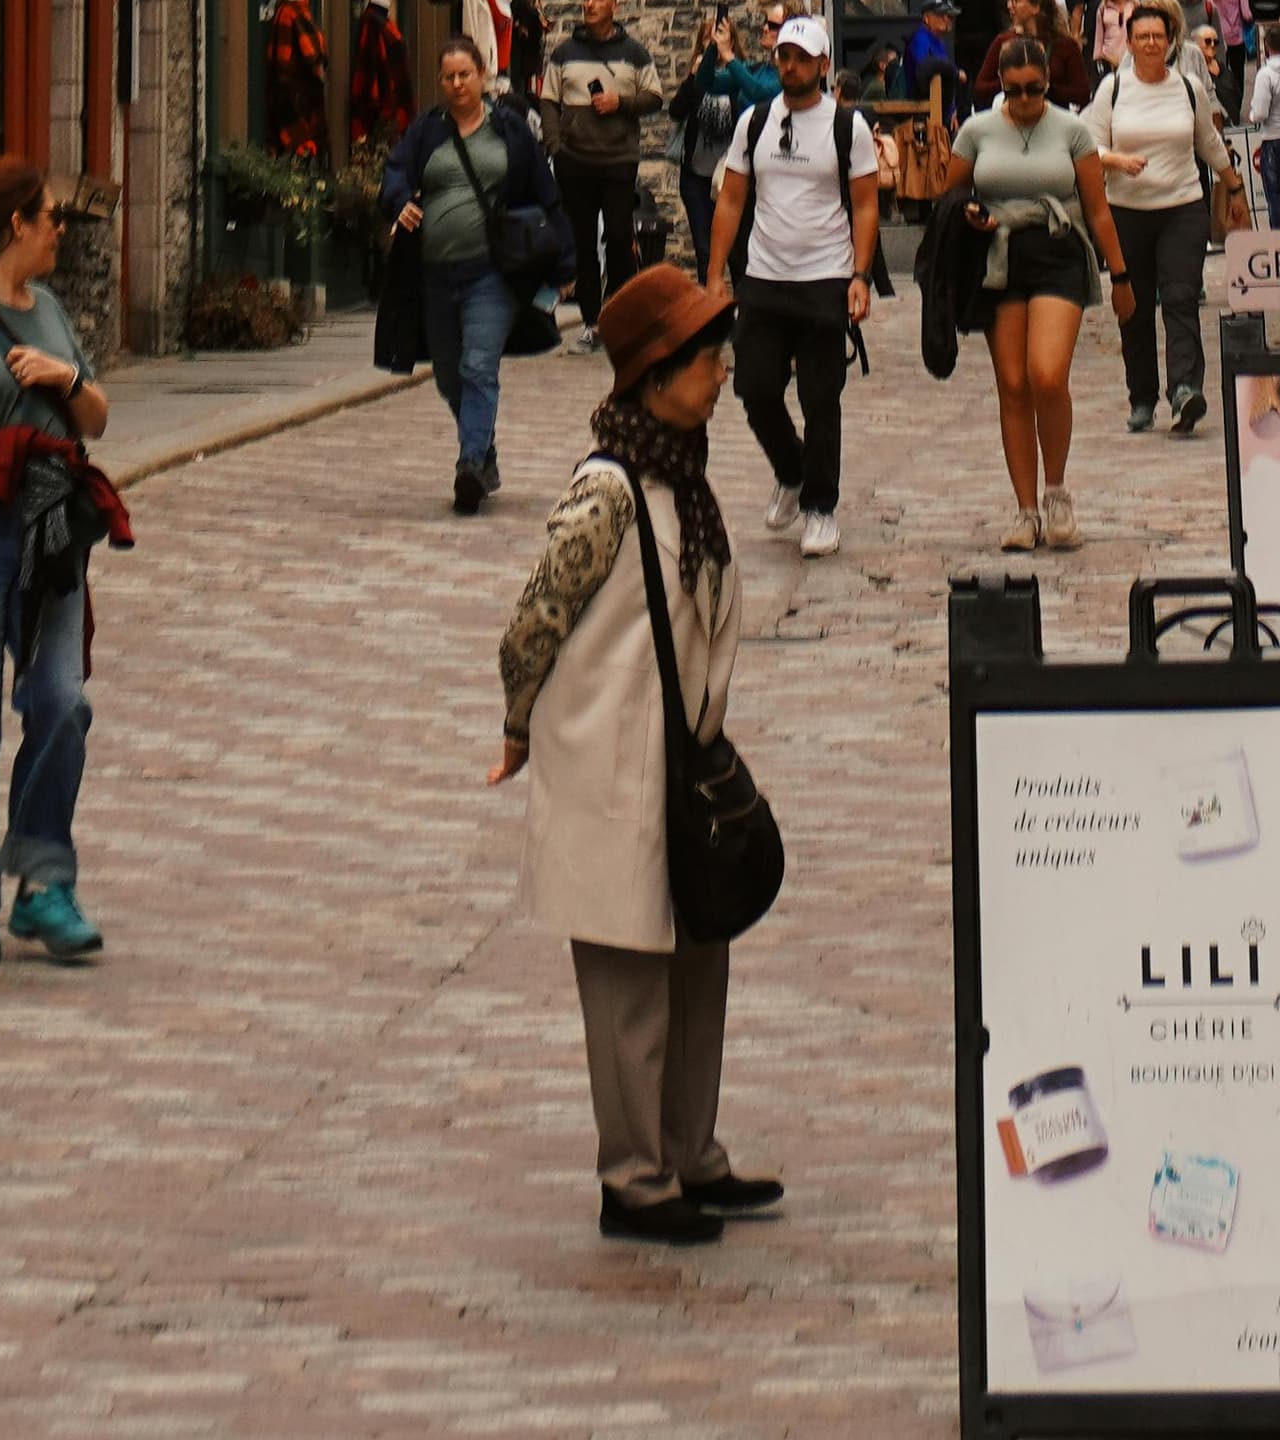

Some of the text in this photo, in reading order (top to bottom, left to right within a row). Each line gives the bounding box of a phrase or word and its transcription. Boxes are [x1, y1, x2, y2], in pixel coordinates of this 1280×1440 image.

[1014, 773, 1101, 799] Produits
[1014, 808, 1141, 832] de créateurs
[1015, 843, 1096, 871] uniques
[1141, 944, 1260, 988] LILI
[1150, 1012, 1252, 1041] CHÉRIE
[1130, 1063, 1224, 1087] BOUTIQUE
